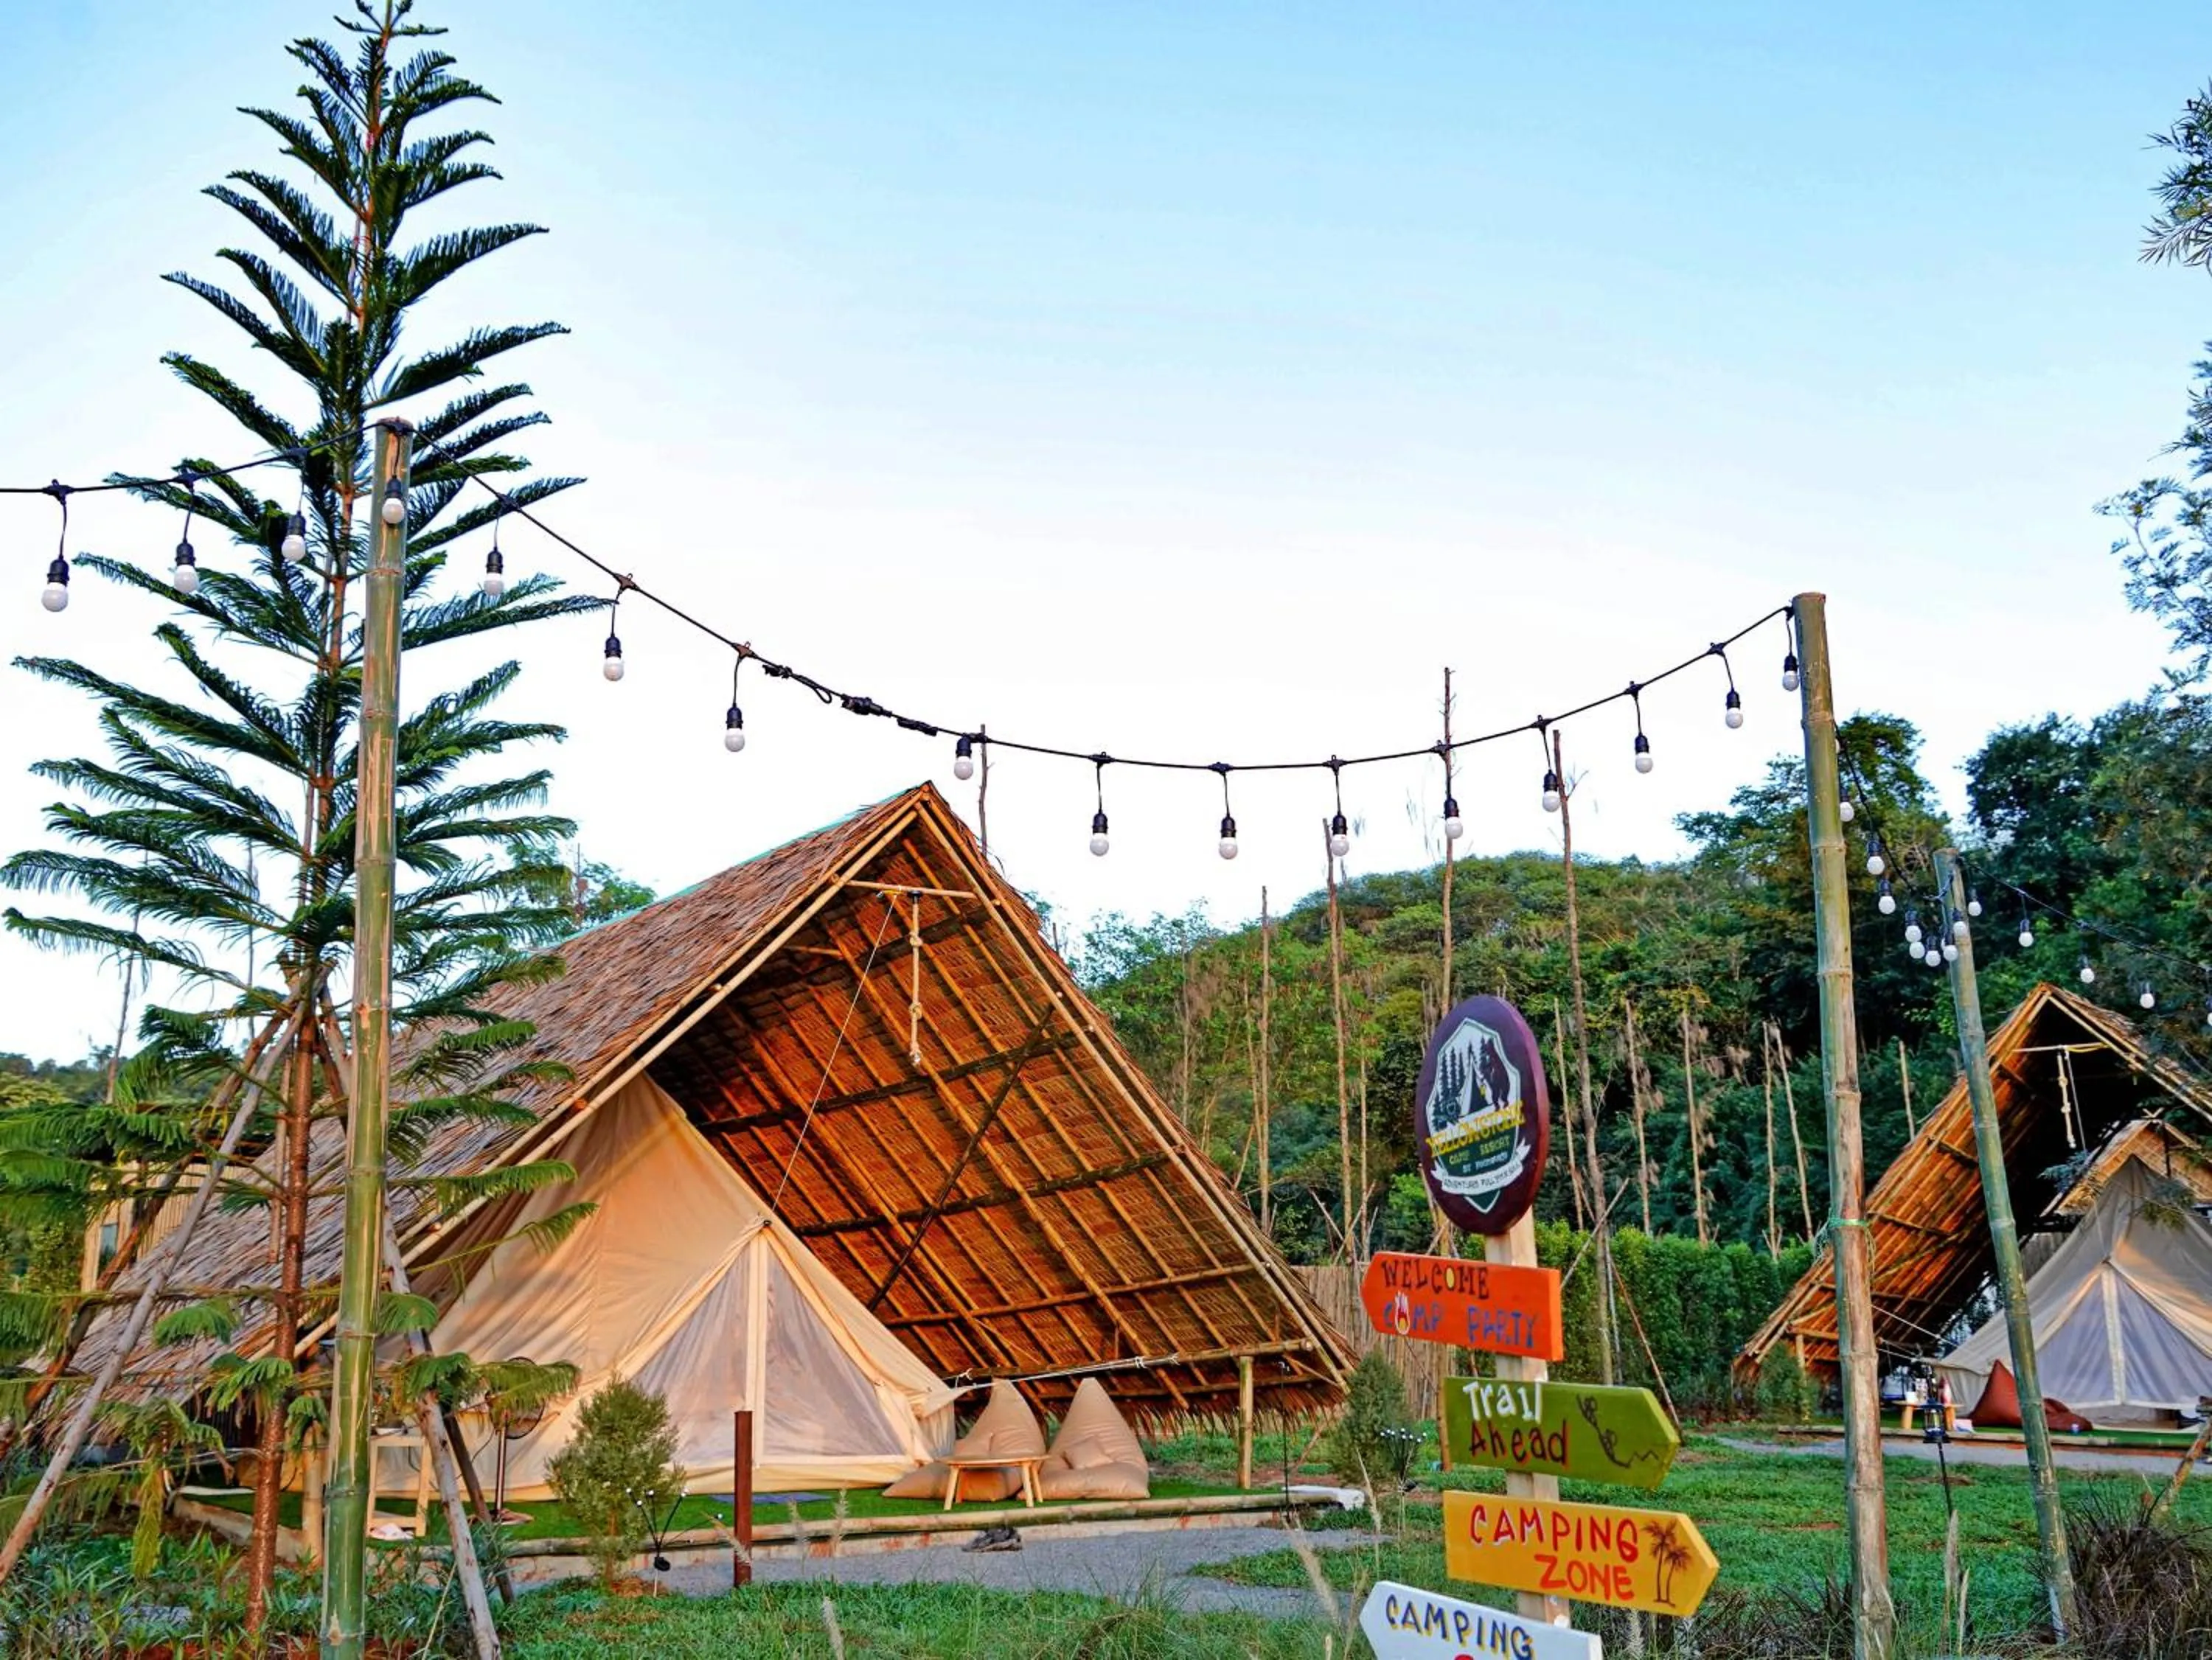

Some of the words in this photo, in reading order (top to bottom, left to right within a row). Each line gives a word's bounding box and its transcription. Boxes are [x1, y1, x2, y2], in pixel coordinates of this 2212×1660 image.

[1425, 1099, 1526, 1157] YELLOWSTONE
[1381, 1258, 1489, 1300] WELCOME
[1467, 1305, 1539, 1349] PARTY
[1463, 1380, 1543, 1424] Trail
[1470, 1418, 1570, 1470] Ahead
[1470, 1504, 1639, 1563] CAMPING
[1534, 1554, 1635, 1601] ZONE
[1385, 1594, 1534, 1660] CAMPING
